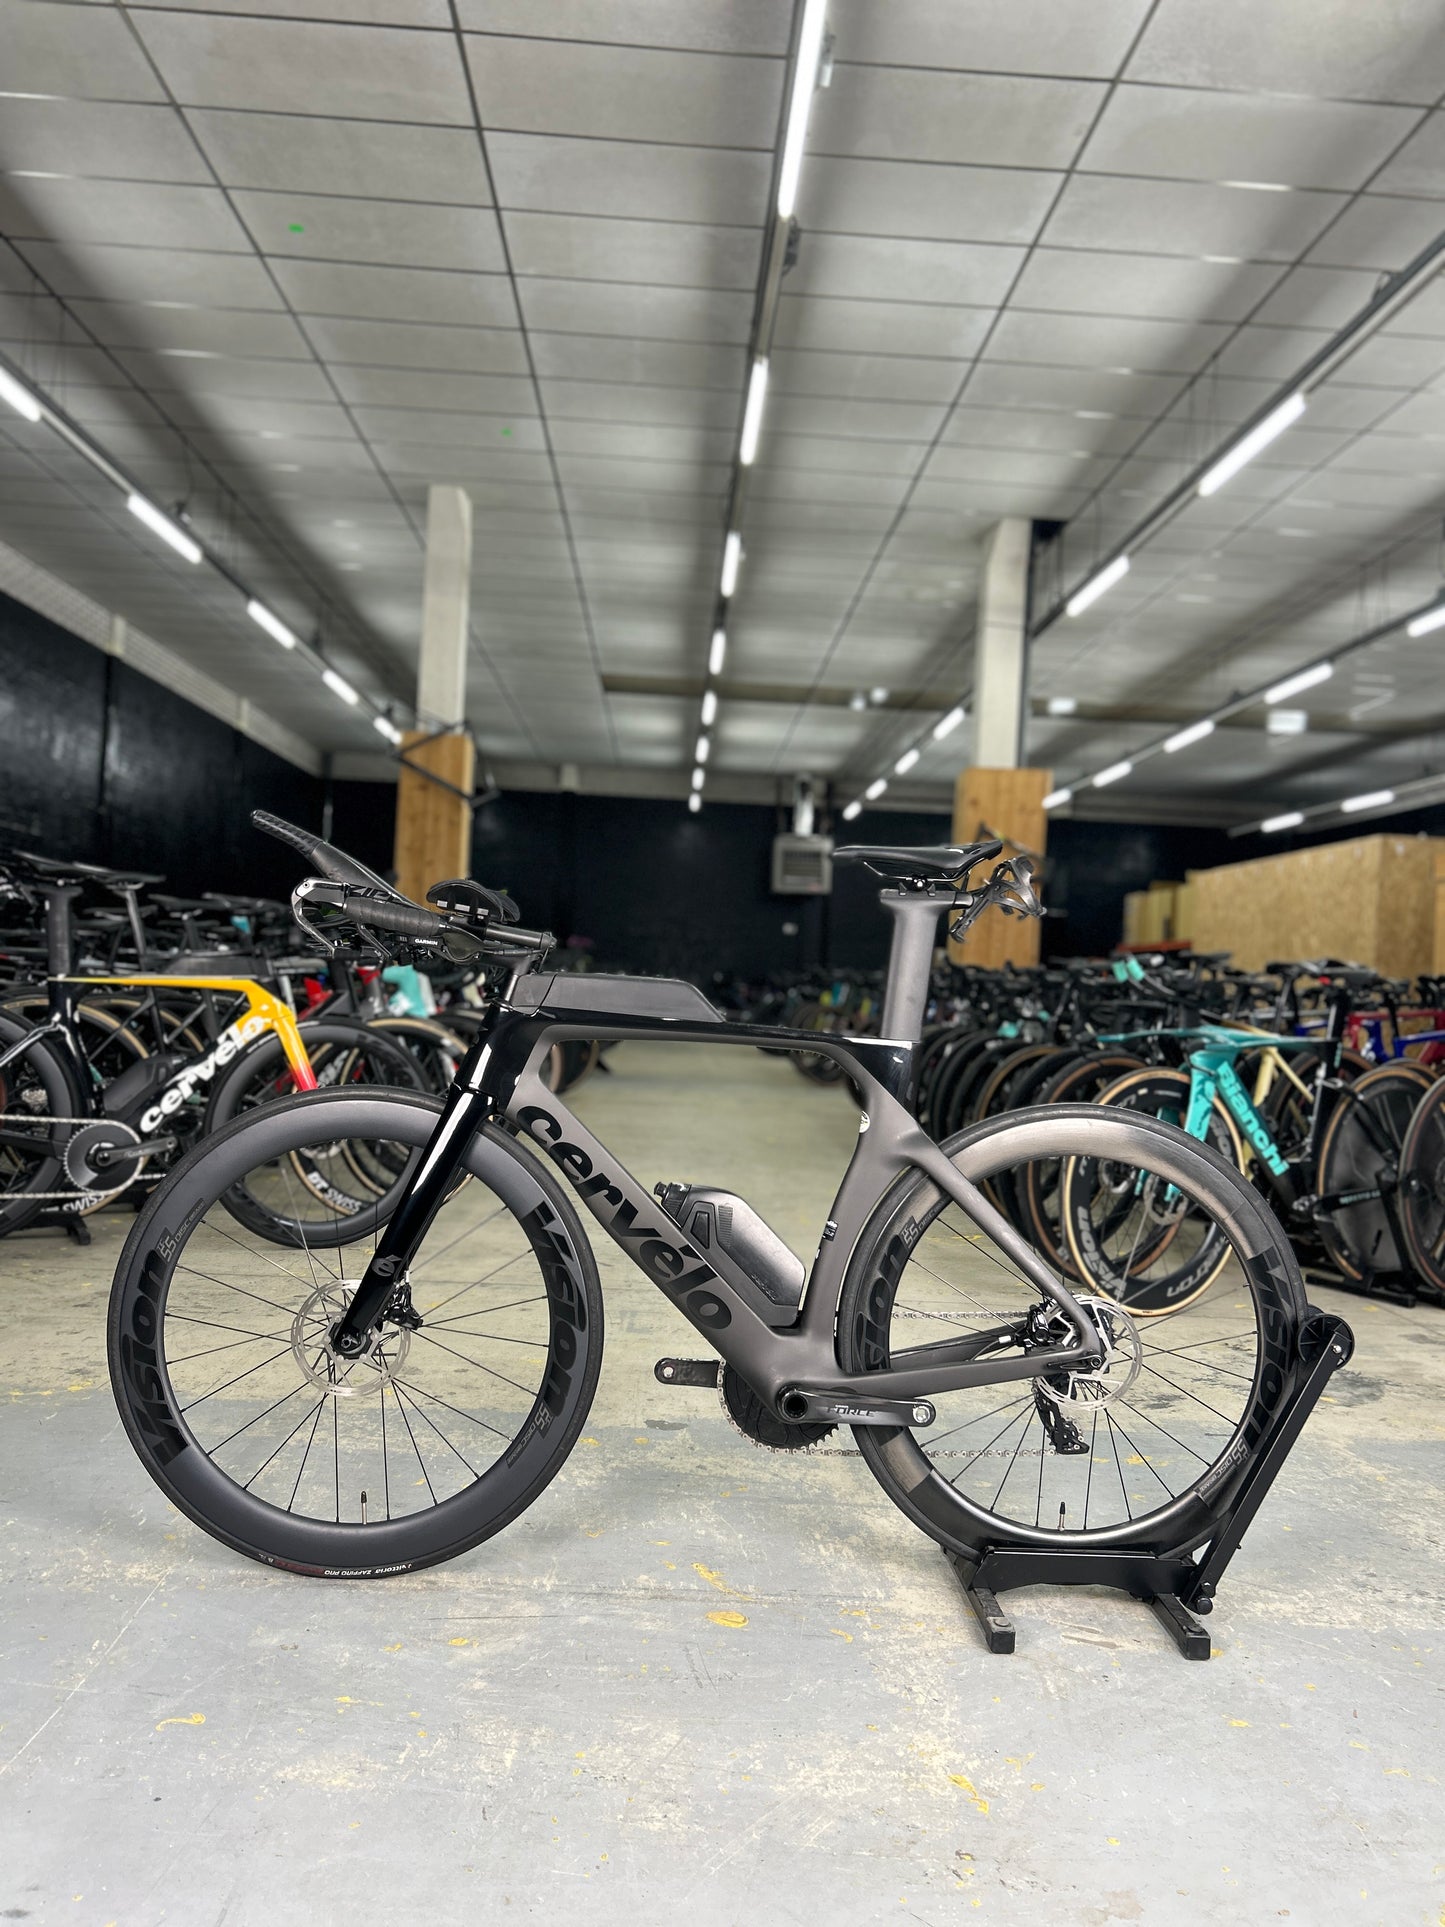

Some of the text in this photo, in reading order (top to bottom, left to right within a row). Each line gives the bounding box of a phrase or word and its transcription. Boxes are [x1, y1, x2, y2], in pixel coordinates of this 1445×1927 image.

[414, 938, 438, 946] GARMIN
[1217, 1061, 1290, 1176] Bianchi
[307, 1171, 362, 1213] DT SWISS
[517, 1106, 732, 1329] cervélo
[160, 1236, 177, 1262] 55
[174, 1218, 190, 1242] DISC
[903, 1223, 919, 1248] 55
[534, 1402, 550, 1430] 55
[826, 1404, 875, 1417] FORCE
[521, 1422, 536, 1447] DISC
[1231, 1438, 1248, 1465] 55
[1215, 1456, 1232, 1478] DISC
